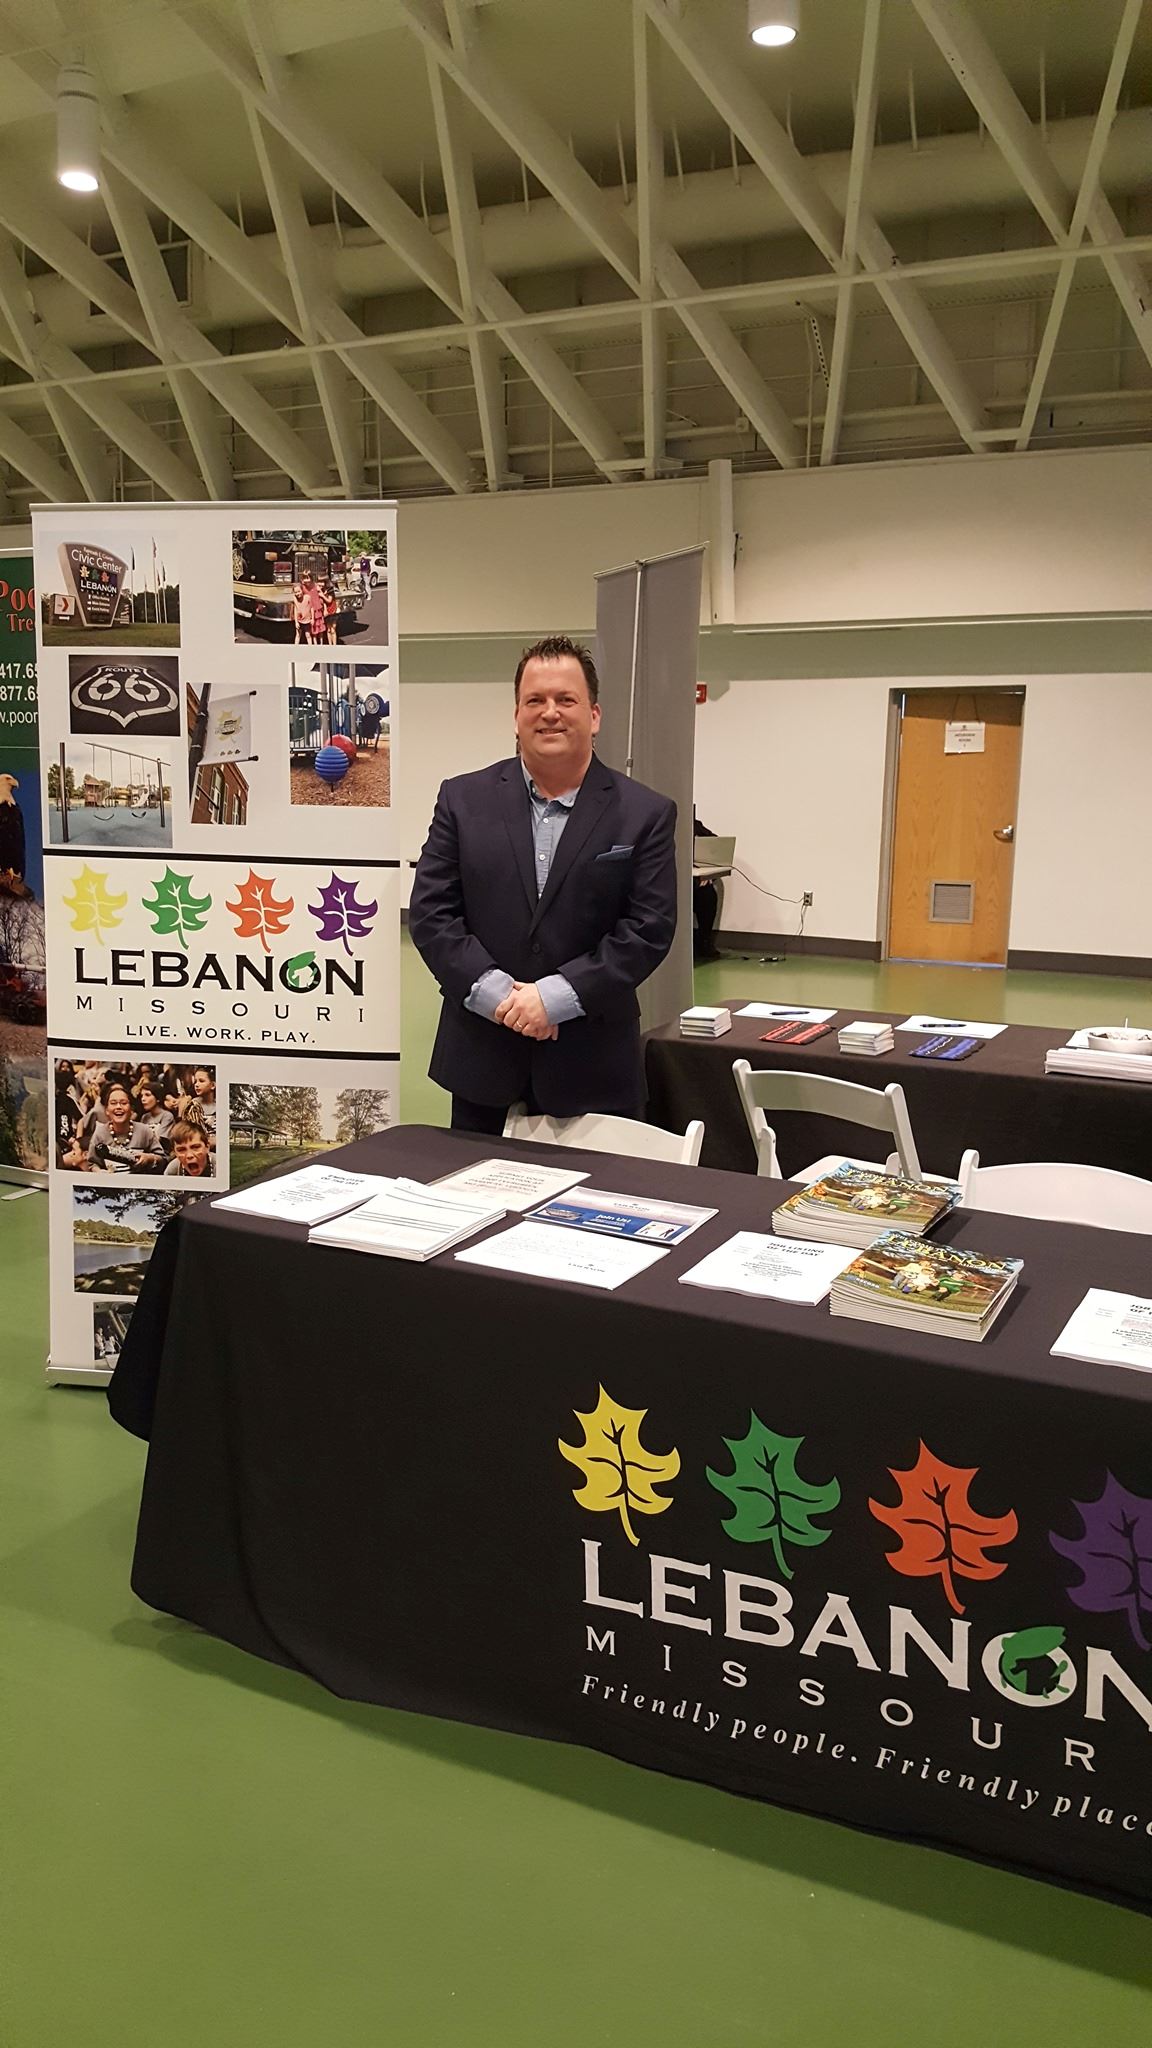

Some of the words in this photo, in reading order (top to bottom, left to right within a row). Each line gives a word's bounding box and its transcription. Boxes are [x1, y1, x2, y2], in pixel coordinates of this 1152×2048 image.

[71, 549, 95, 565] Civic
[96, 557, 122, 573] Center
[80, 580, 117, 593] LEBANON
[7, 613, 36, 632] Tre
[88, 673, 160, 702] 66
[74, 947, 365, 996] LEBANON
[76, 996, 364, 1023] MISSOURI
[126, 1025, 177, 1037] LIVE.
[187, 1027, 252, 1041] WORK.
[261, 1031, 316, 1043] PLAY.
[787, 1245, 825, 1254] LISTING
[888, 1235, 1006, 1271] LEBANON
[581, 1538, 1152, 1733] LEBANON
[582, 1674, 720, 1732] Friendly
[731, 1718, 857, 1762] people.
[875, 1747, 1040, 1810] Friendly
